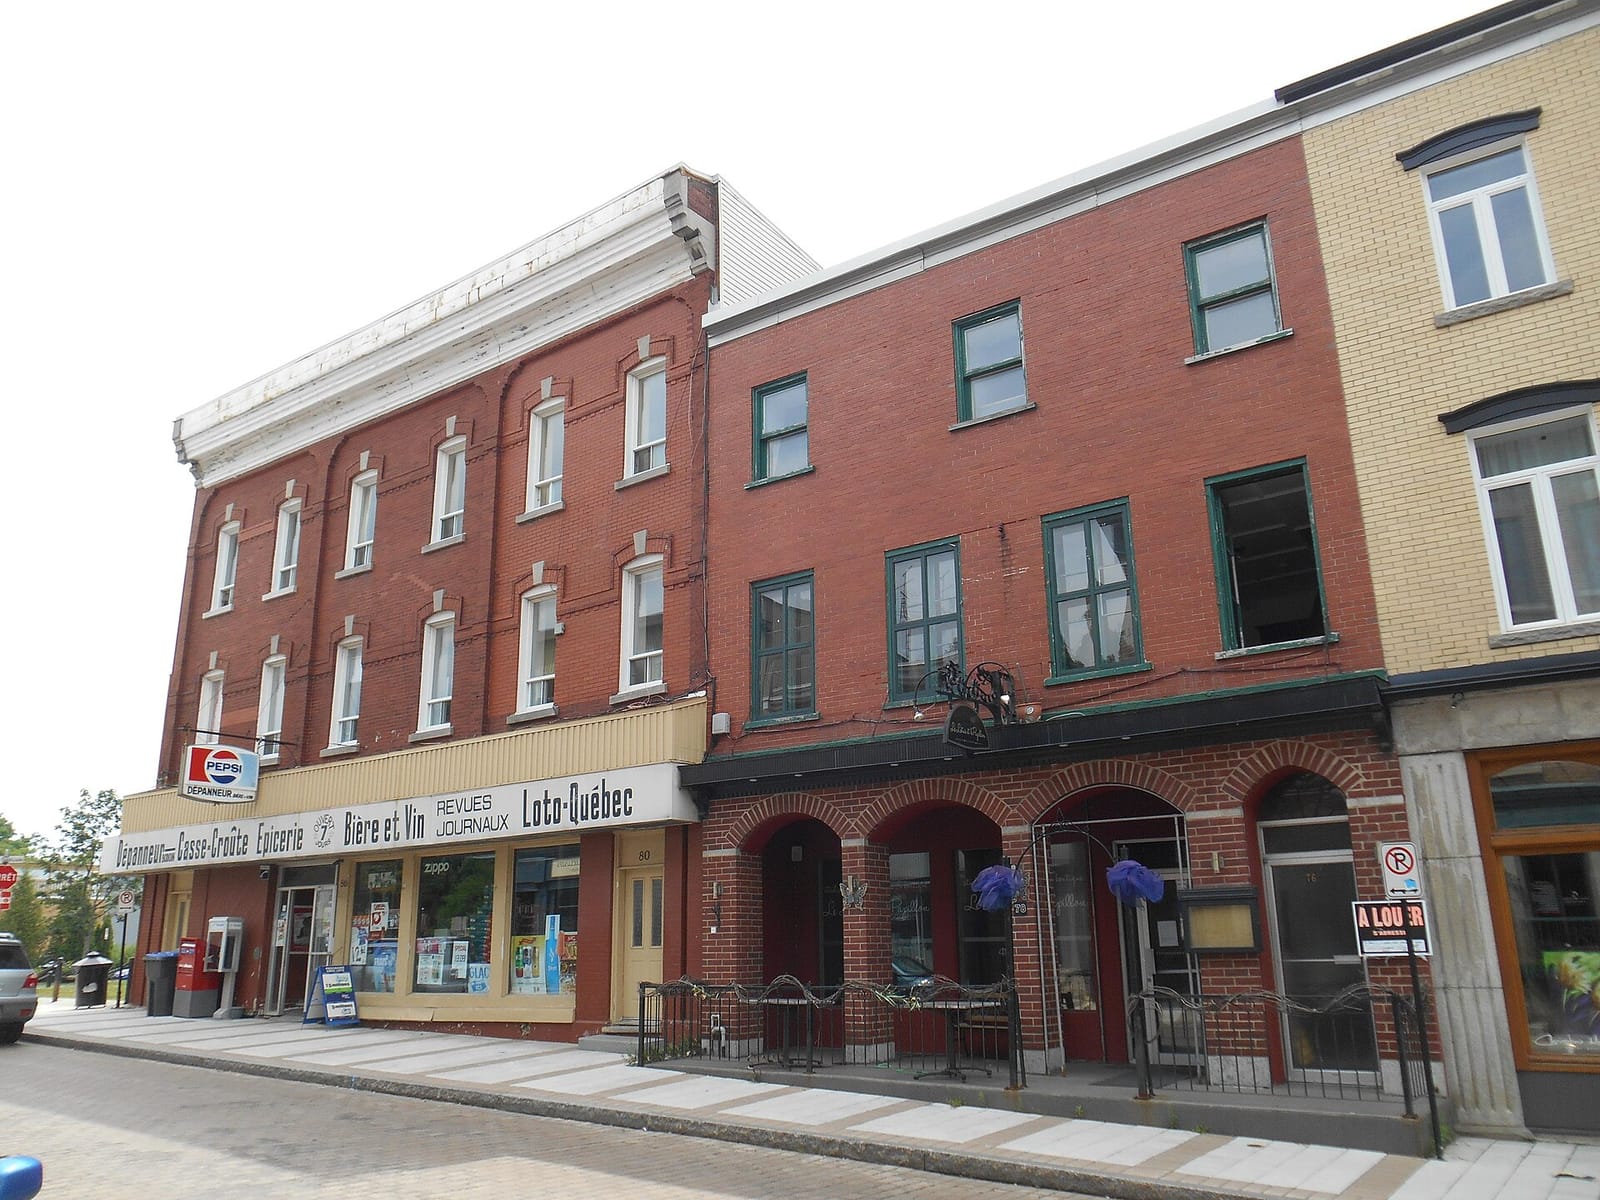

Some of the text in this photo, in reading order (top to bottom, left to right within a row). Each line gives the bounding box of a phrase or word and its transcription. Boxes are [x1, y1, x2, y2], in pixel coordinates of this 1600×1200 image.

[207, 761, 242, 774] PEPSI
[436, 794, 492, 816] REVUES
[523, 778, 633, 827] Loto-Québec
[313, 813, 336, 832] OUVERT
[320, 825, 328, 841] 7
[343, 803, 425, 846] Bière et Vin
[436, 813, 509, 837] JOURNAUX
[177, 825, 249, 861] Casse-Croûte
[256, 822, 304, 857] Epicerie
[116, 839, 166, 869] Dépanneur
[638, 850, 651, 861] 80
[424, 862, 449, 875] zippo
